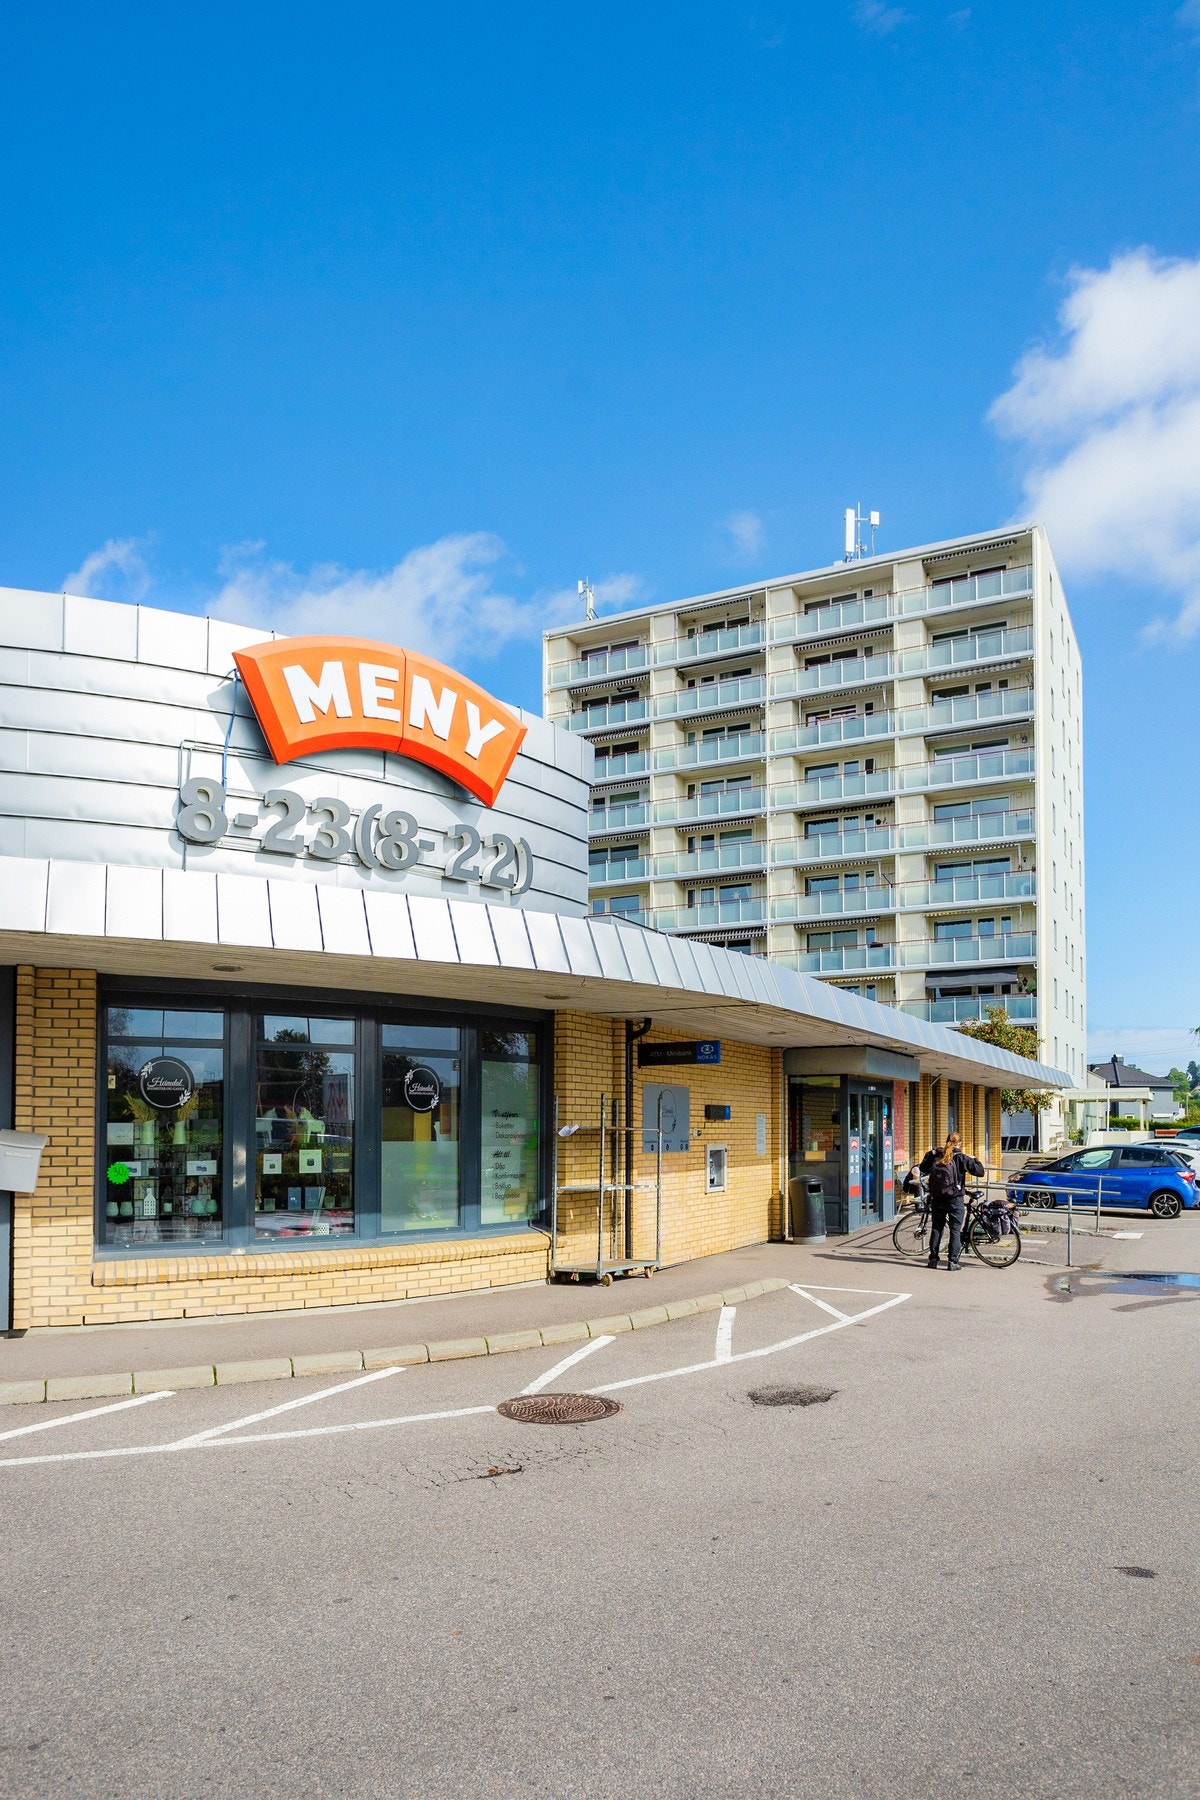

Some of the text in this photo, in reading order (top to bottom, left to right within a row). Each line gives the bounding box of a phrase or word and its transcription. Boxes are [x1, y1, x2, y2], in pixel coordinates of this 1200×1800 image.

[282, 661, 505, 760] MENY
[495, 1172, 526, 1180] Konfirmasjon
[495, 1182, 511, 1191] Bryllup
